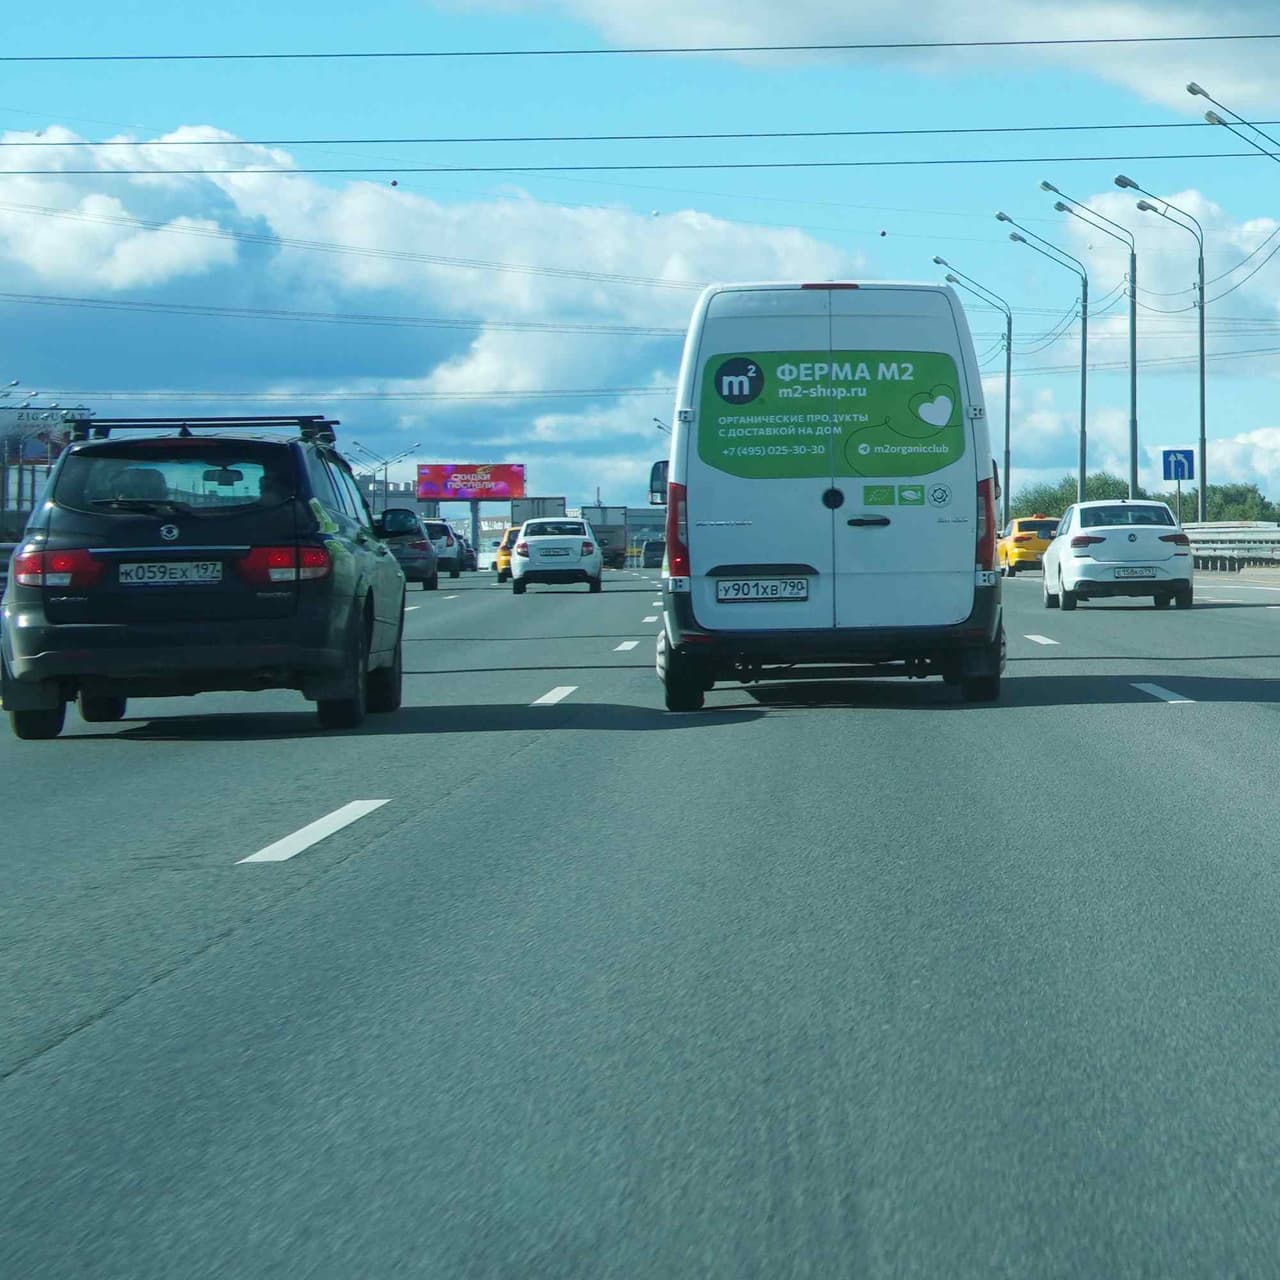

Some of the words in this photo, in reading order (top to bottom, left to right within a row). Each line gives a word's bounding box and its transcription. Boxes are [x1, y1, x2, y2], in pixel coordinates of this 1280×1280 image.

[776, 362, 871, 381] ФЕРМА
[877, 363, 914, 380] М2
[778, 385, 867, 400] m2-shop.ru
[718, 414, 805, 425] ОРГАНИЧЕСКИЕ
[806, 413, 869, 423] ПРОДУКТЫ
[718, 429, 726, 438] С
[728, 426, 796, 438] ДОСТАВКОЙ
[798, 427, 814, 436] НА
[816, 426, 842, 436] ДОМ
[767, 445, 825, 456] 025-30-30
[874, 444, 949, 456] m2organicclub
